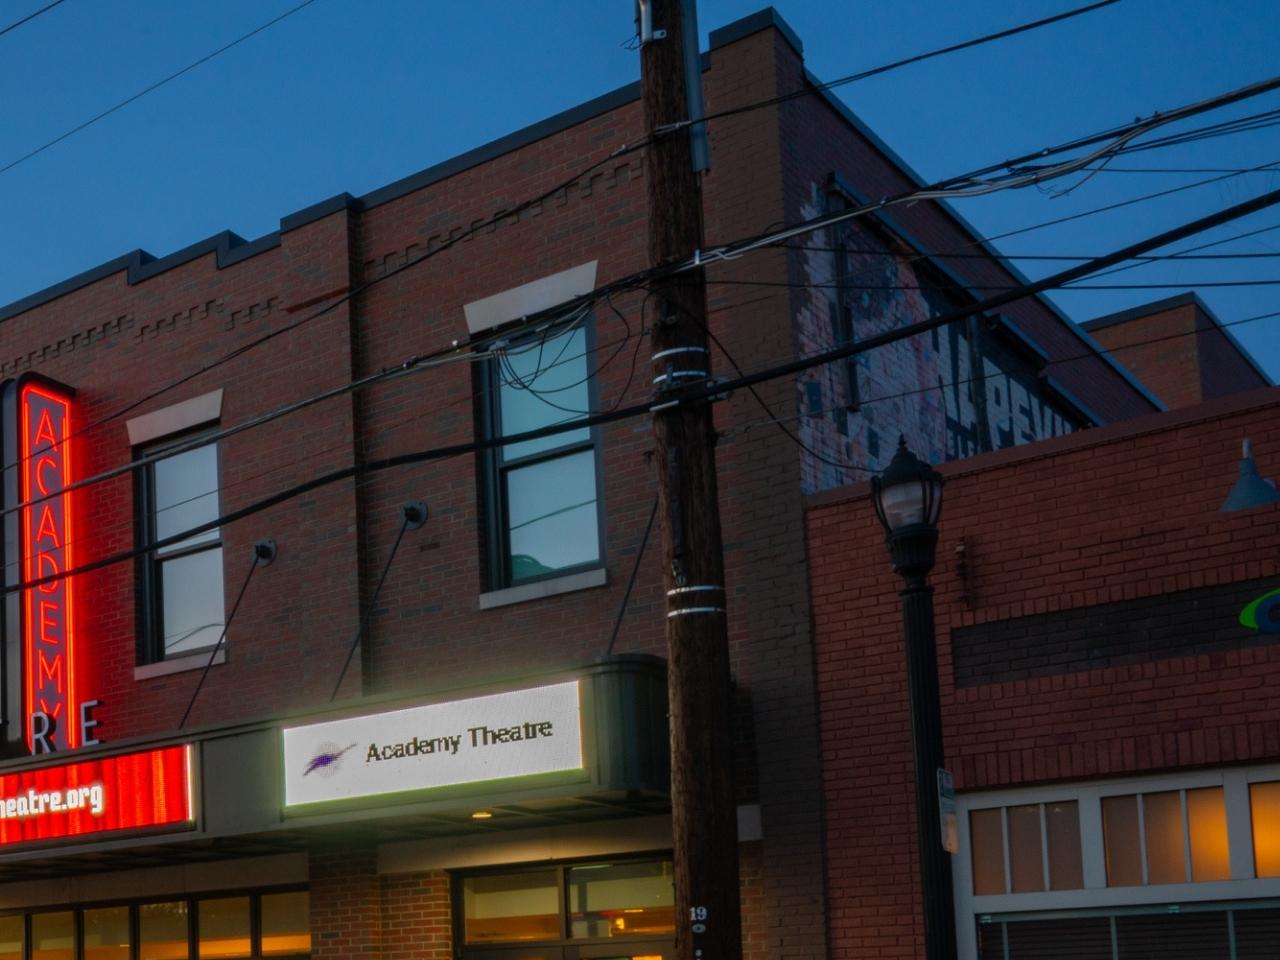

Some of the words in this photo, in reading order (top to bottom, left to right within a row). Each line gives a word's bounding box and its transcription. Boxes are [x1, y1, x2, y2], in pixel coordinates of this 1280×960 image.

[34, 408, 64, 742] ACADEMY
[366, 735, 462, 763] Academy
[468, 720, 553, 748] Theatre
[689, 906, 708, 921] 19
